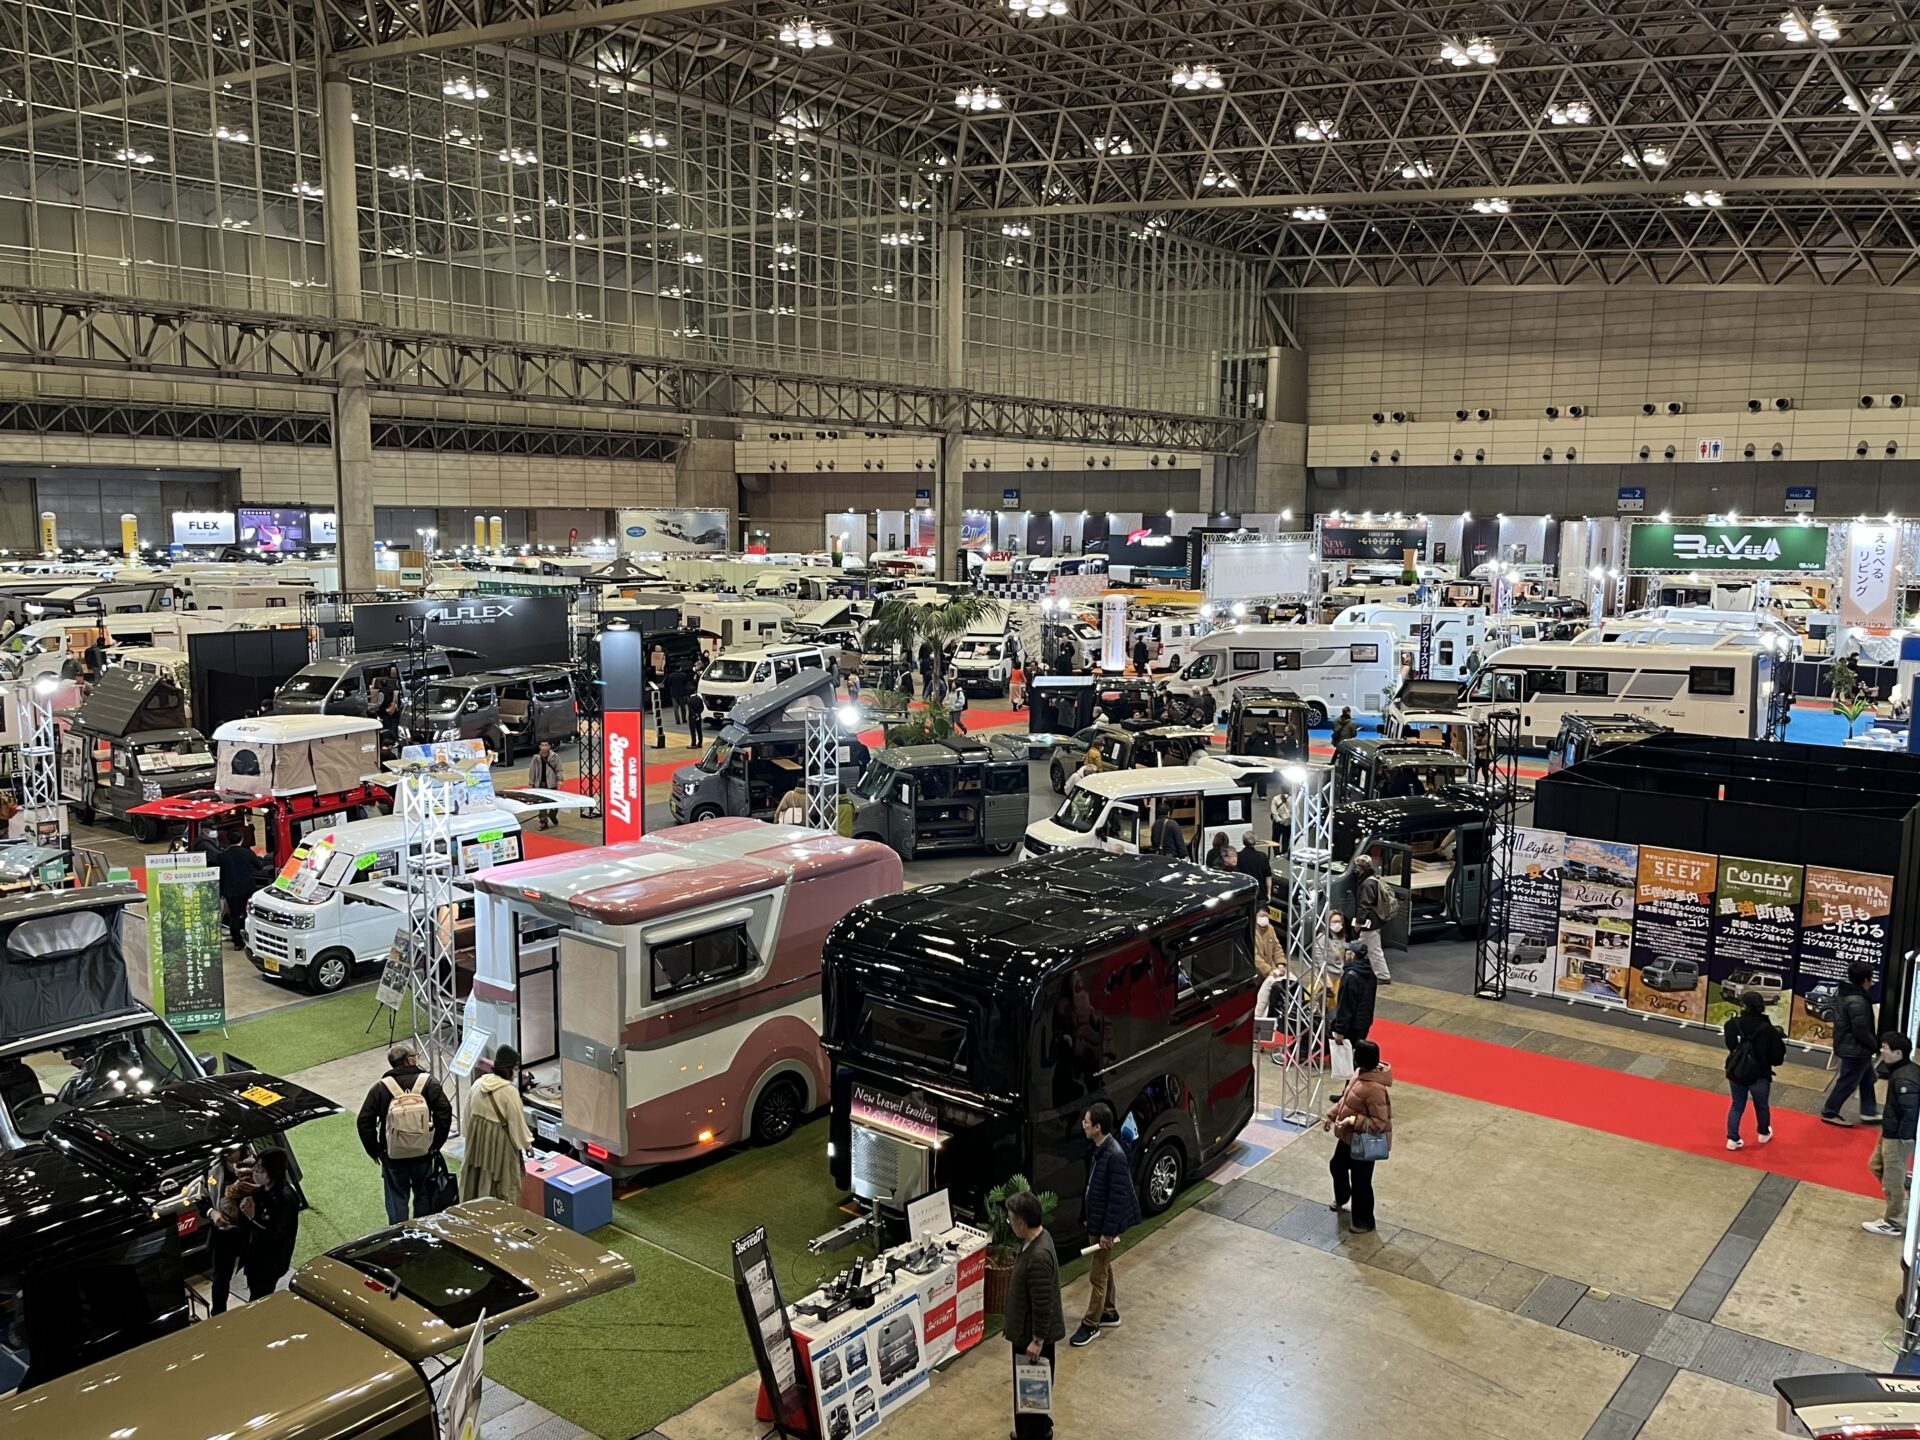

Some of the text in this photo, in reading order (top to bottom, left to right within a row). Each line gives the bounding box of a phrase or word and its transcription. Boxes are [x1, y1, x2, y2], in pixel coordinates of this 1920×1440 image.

[1634, 489, 1641, 498] 2
[1789, 489, 1811, 498] HALL 2
[188, 521, 220, 530] FLEX
[323, 522, 336, 530] FL
[1323, 540, 1345, 548] NEW
[906, 547, 928, 557] NEW
[985, 551, 1012, 562] NEW
[1871, 532, 1887, 583] えらべる、
[1855, 551, 1870, 597] リビング
[628, 757, 637, 798] CAR SHOP
[1524, 841, 1559, 859] light
[1865, 896, 1888, 908] light
[1718, 897, 1795, 923] 最強断熱
[1807, 899, 1871, 921] 見た目も
[1675, 919, 1710, 928] ならコレ!
[1731, 918, 1795, 937] 装備にこだわった
[1821, 917, 1885, 939] こだわる
[854, 1087, 875, 1104] New
[876, 1092, 904, 1113] travel
[905, 1105, 937, 1123] trailer
